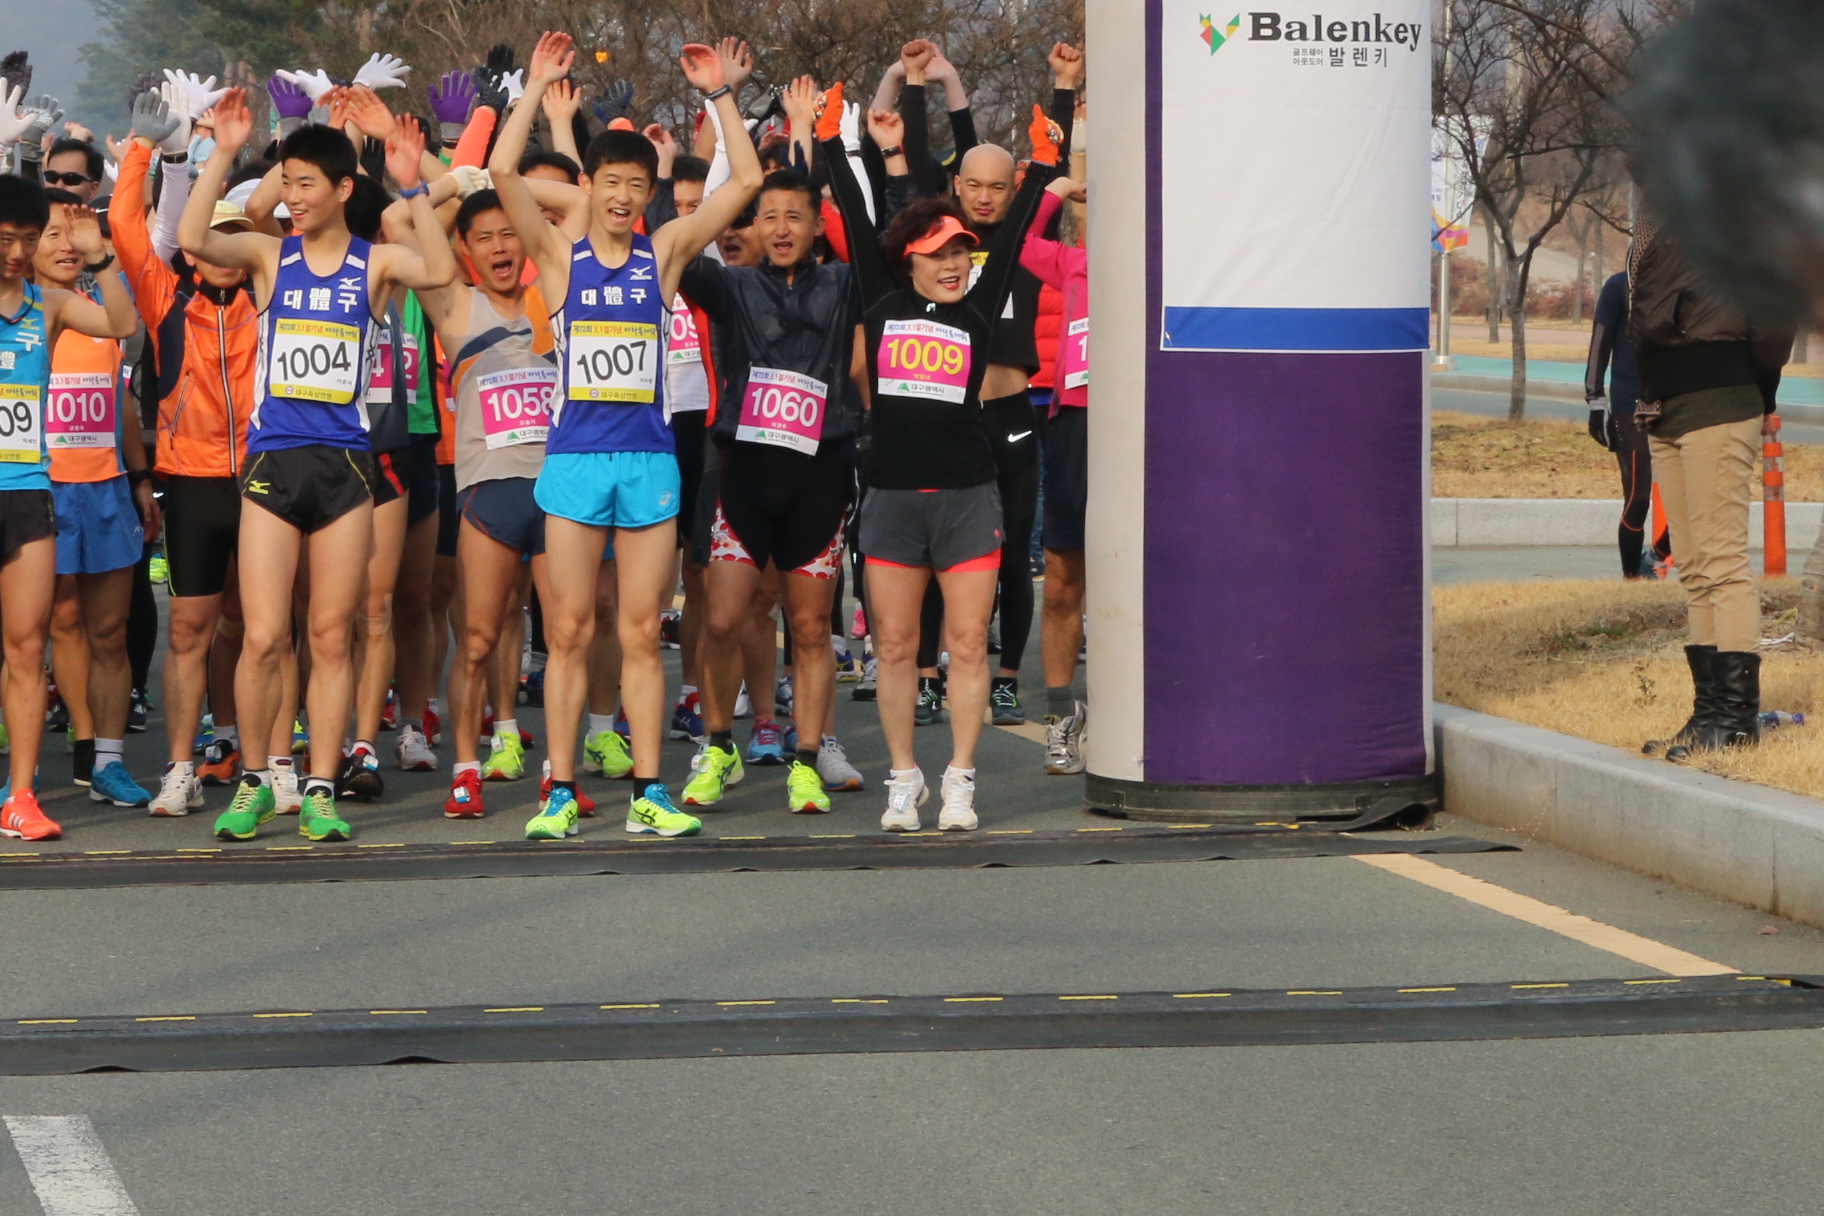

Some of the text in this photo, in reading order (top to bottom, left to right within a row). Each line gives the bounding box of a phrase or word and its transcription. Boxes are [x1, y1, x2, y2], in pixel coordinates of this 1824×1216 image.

[1247, 12, 1422, 51] Balenkey
[277, 341, 351, 381] 1004
[576, 340, 647, 384] 1007
[886, 338, 964, 376] 1009
[47, 391, 106, 423] 1010
[487, 386, 553, 422] 1058
[751, 387, 818, 428] 1060
